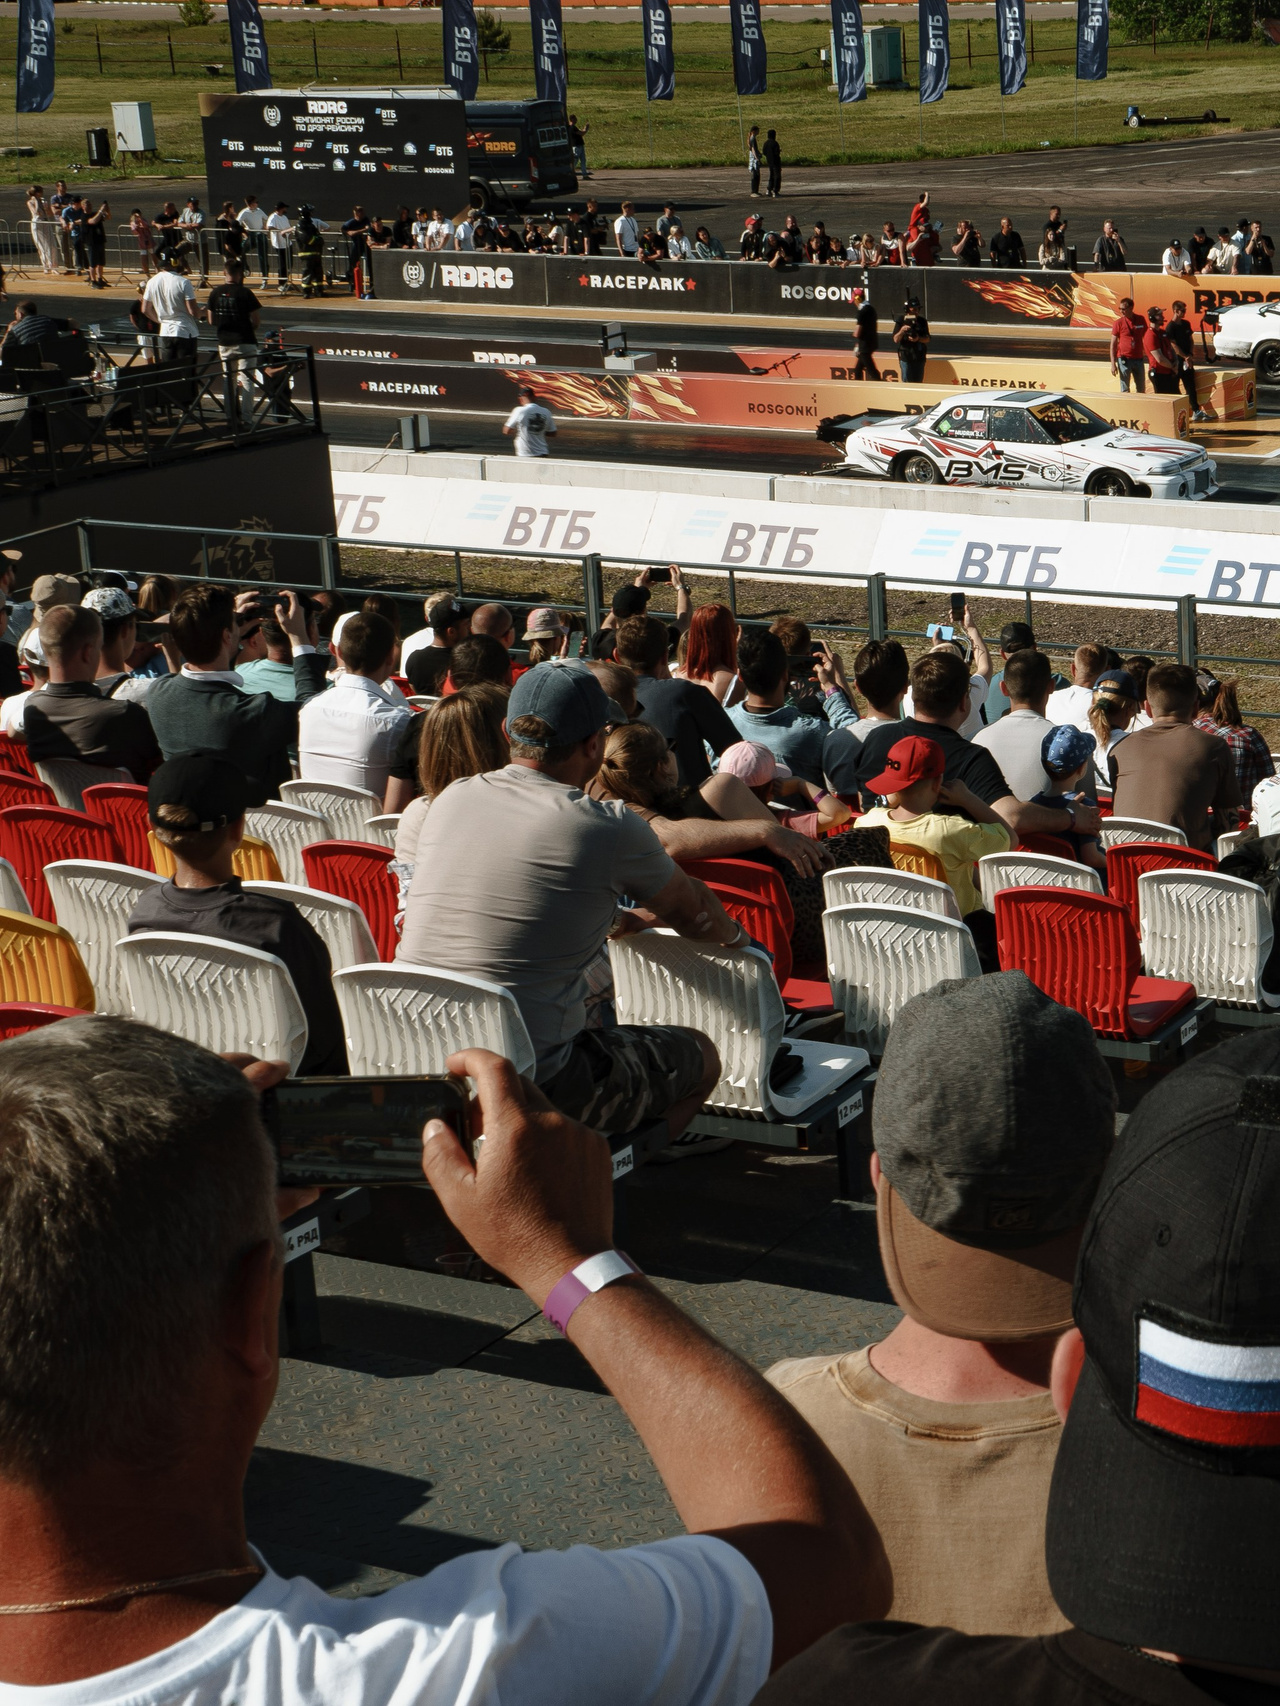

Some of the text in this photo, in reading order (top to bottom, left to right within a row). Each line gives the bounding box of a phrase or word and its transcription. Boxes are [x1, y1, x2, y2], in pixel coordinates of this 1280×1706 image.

[650, 9, 666, 46] ВТБ
[741, 3, 759, 39] ВТБ
[841, 11, 858, 47] ВТБ
[928, 14, 943, 49] ВТБ
[1006, 6, 1021, 41] ВТБ
[30, 19, 48, 56] ВТБ
[242, 21, 262, 59] ВТБ
[454, 26, 472, 64] ВТБ
[541, 18, 559, 55] ВТБ
[307, 100, 348, 114] RDRC
[381, 109, 396, 119] ВТБ
[292, 116, 365, 125] ЧЕМПИОНАТ РОССИИ
[228, 141, 244, 151] ВТБ
[332, 144, 349, 154] ВТБ
[436, 147, 453, 156] ВТБ
[485, 141, 516, 151] RDRC
[269, 160, 286, 170] ВТБ
[360, 162, 377, 172] ВТБ
[440, 264, 514, 289] RDRC
[589, 274, 686, 291] RACEPARK
[781, 285, 869, 301] ROSGONI
[368, 381, 439, 396] RACEPARK
[960, 378, 1038, 389] RACEPARK
[747, 402, 818, 417] ROSGONKI
[944, 460, 1029, 482] BMS
[335, 493, 386, 535] ТБ
[502, 505, 597, 551] ВТБ
[721, 521, 820, 569] ВТБ
[956, 541, 1063, 588] ВТБ
[838, 1098, 863, 1120] 12 РЯД
[616, 1154, 633, 1170] РЯД
[297, 1227, 319, 1247] РЯД
